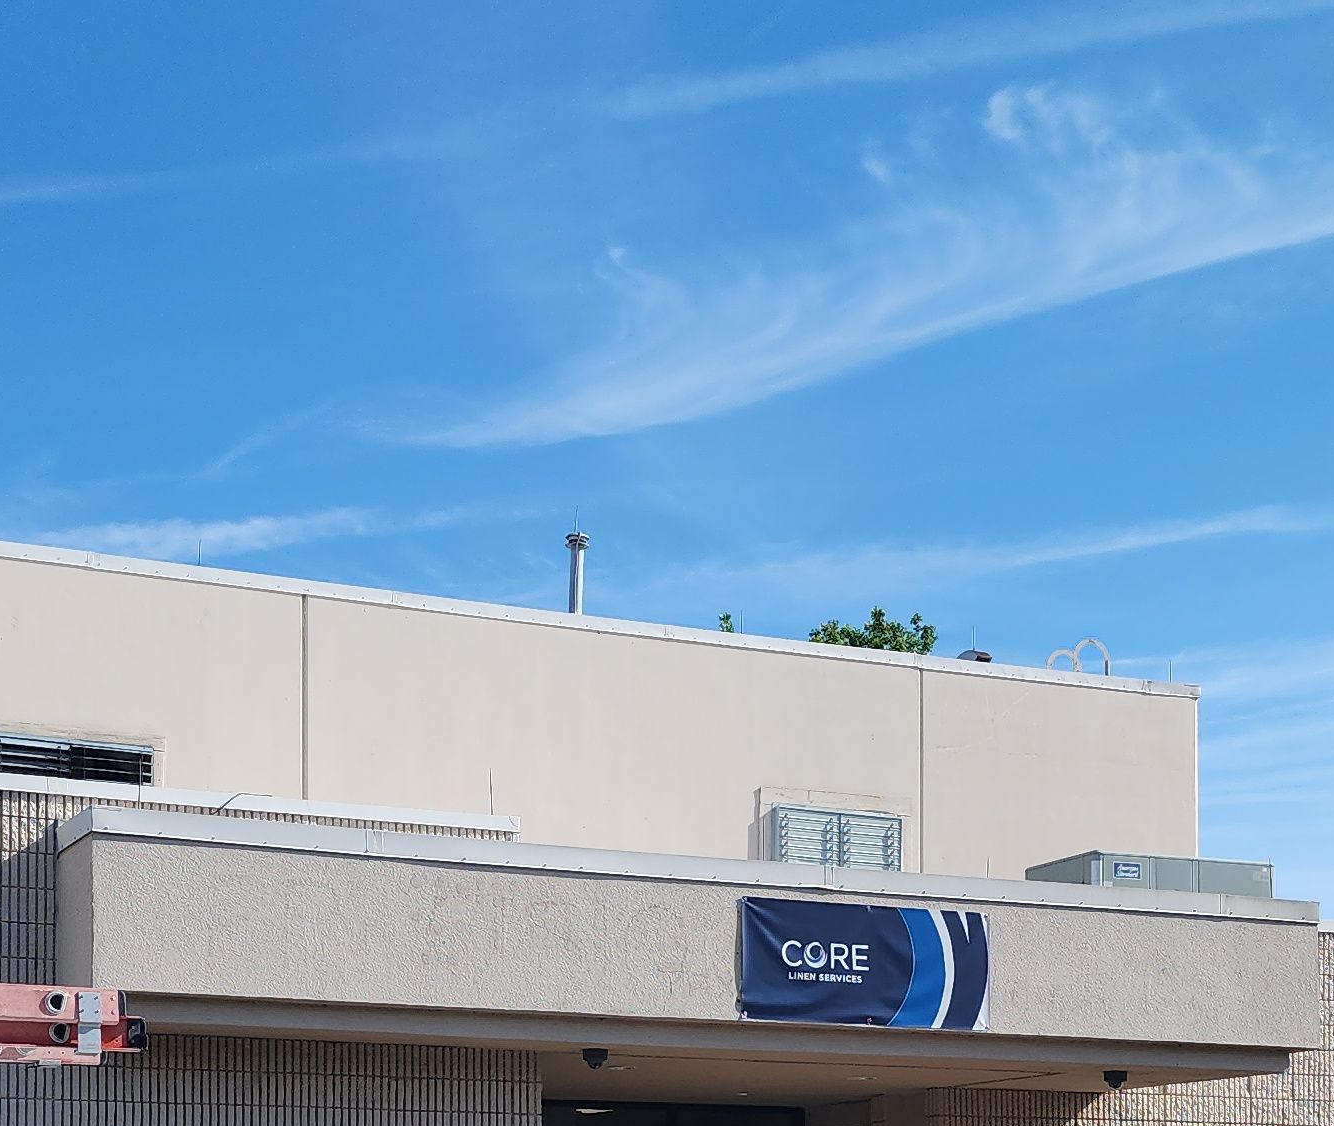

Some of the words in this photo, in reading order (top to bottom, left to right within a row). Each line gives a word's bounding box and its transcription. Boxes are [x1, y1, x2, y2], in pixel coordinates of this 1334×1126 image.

[781, 940, 870, 971] CORE
[788, 971, 816, 981] LINEN
[818, 973, 863, 984] SERVICES
